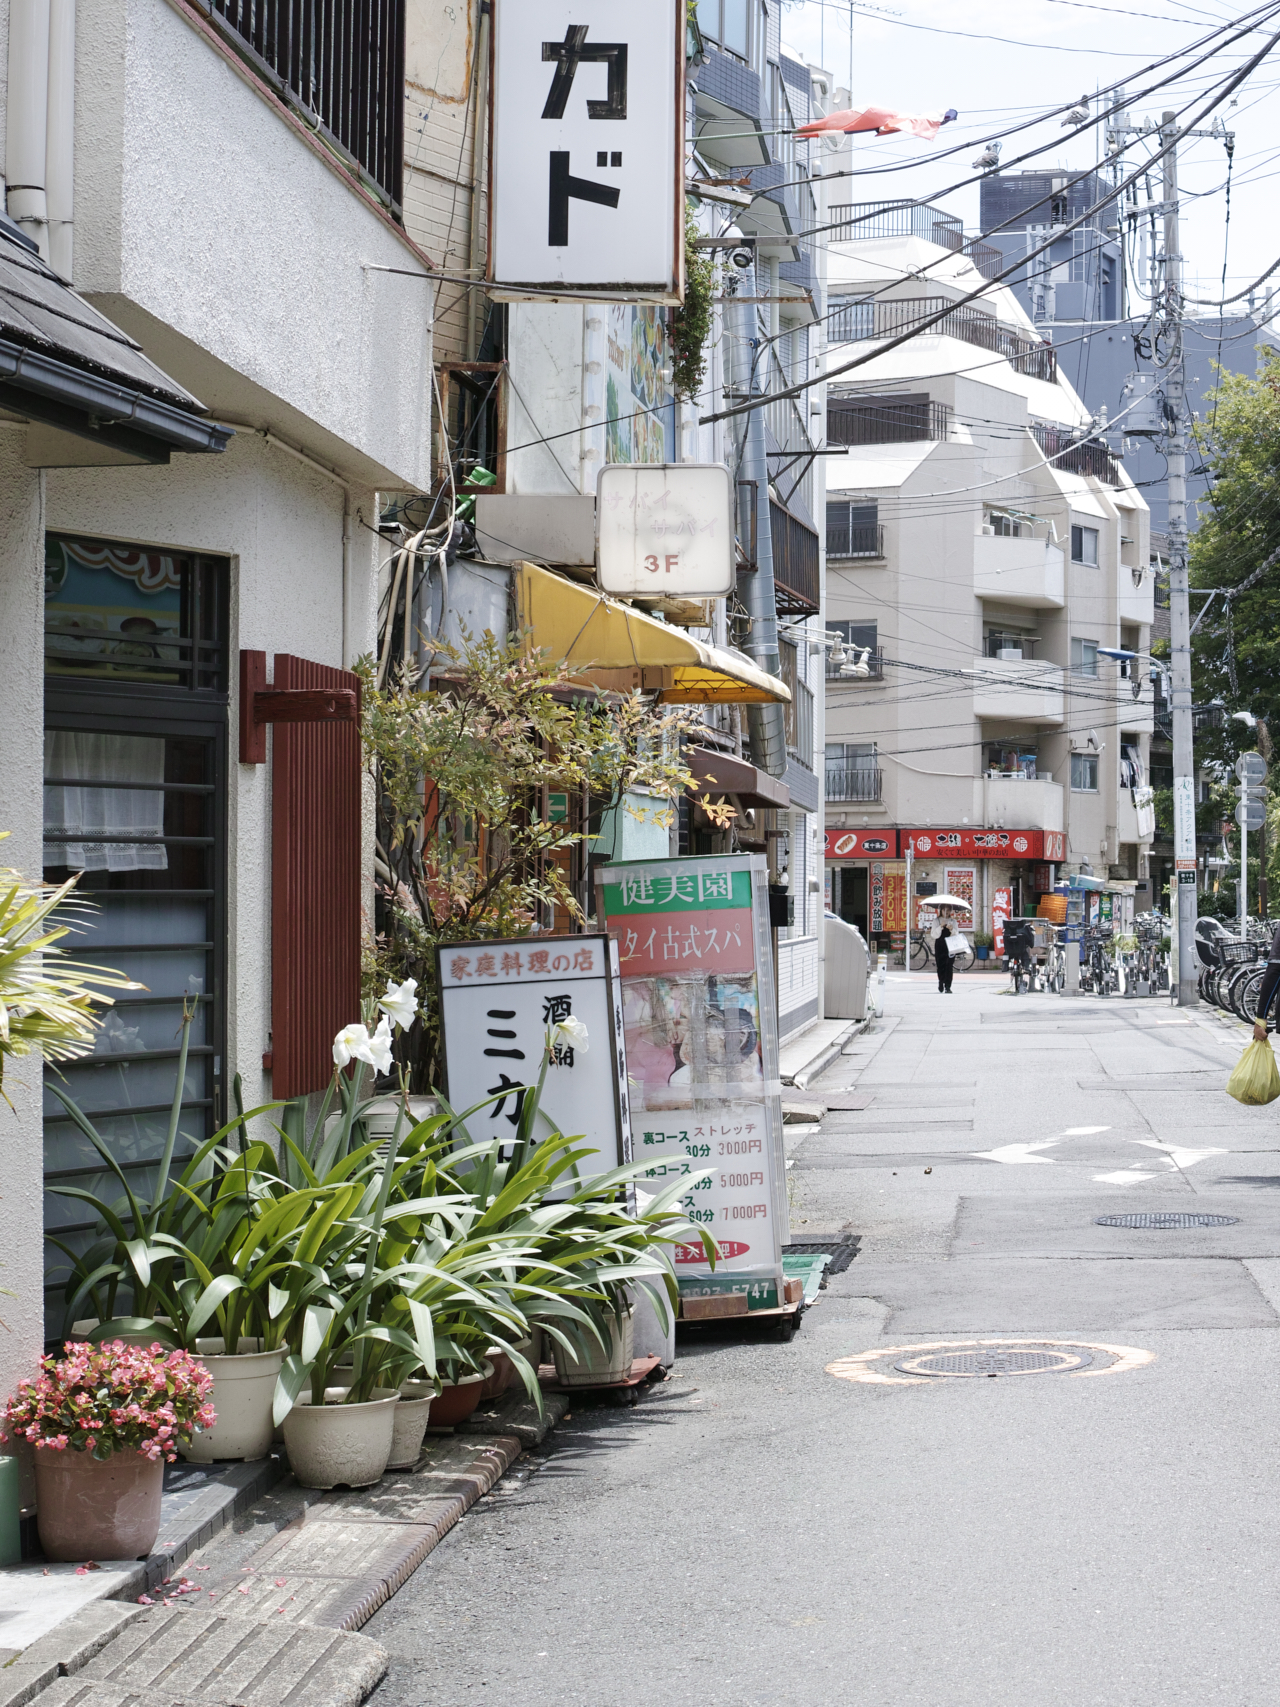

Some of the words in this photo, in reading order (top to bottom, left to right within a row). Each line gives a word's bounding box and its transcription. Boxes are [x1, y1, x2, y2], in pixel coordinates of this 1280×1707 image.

[541, 24, 628, 247] カド
[650, 517, 718, 539] サバイ
[619, 866, 734, 906] 健美園
[624, 922, 741, 960] タイ古式スパ
[450, 947, 594, 980] 家庭料理の店
[694, 1123, 758, 1137] ストレッチ
[718, 1140, 762, 1156] 3000円
[720, 1172, 764, 1188] 5000円
[722, 1204, 767, 1221] 7000円
